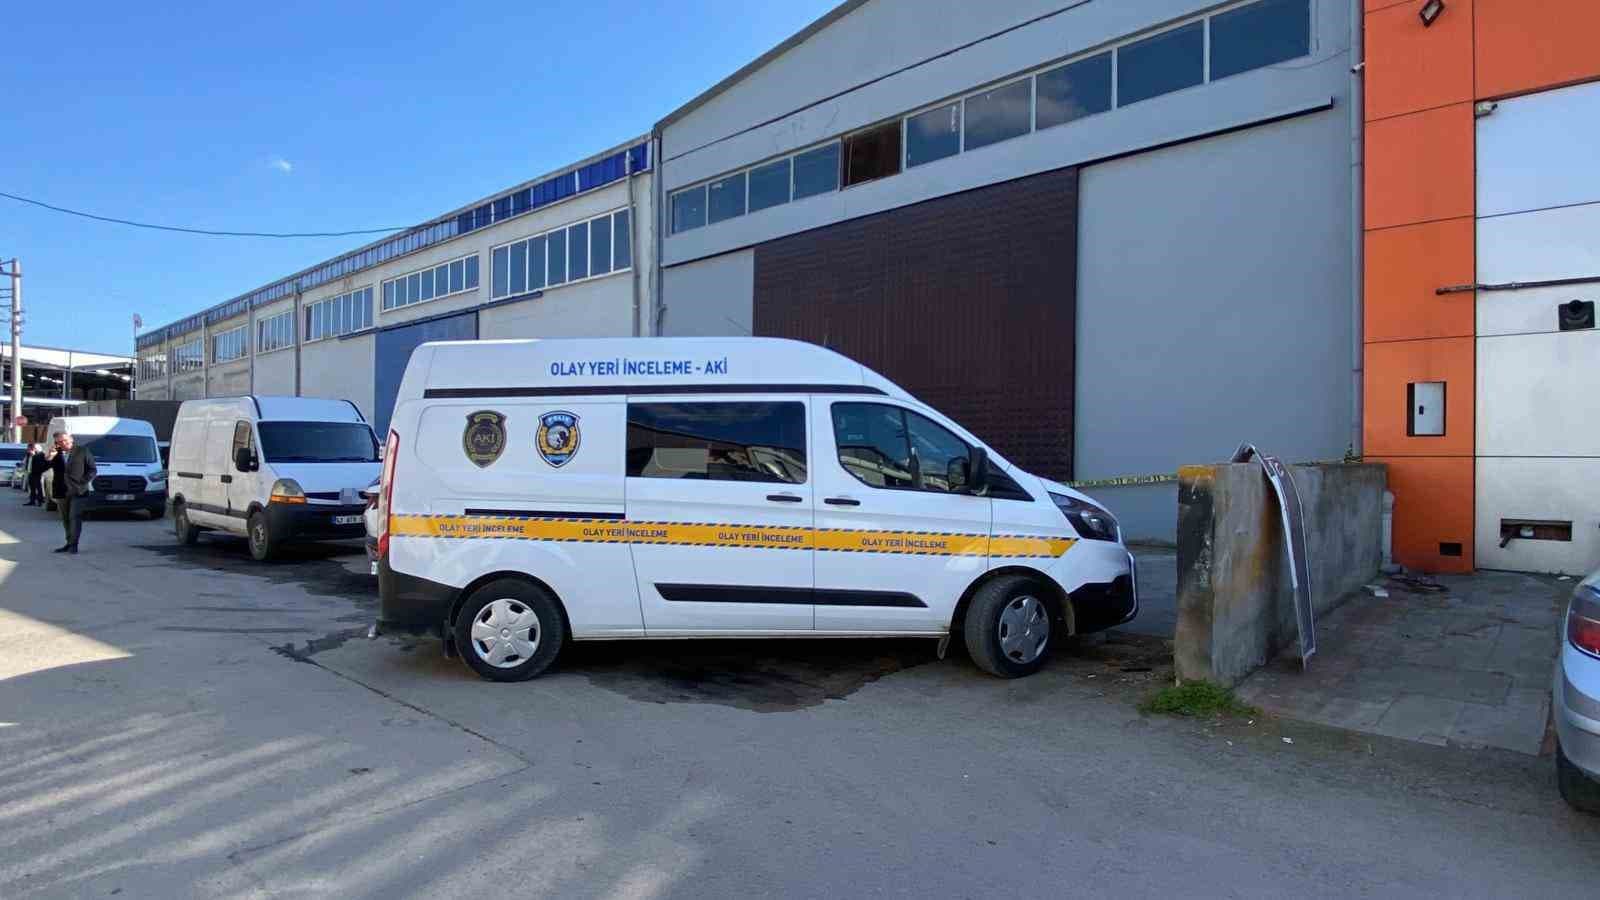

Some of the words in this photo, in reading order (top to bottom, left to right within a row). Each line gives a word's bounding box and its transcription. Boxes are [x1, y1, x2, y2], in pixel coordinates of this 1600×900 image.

[551, 361, 586, 376] OLAY
[588, 357, 619, 376] YERİ
[623, 357, 692, 376] İNCELEME
[704, 356, 728, 375] AKİ
[440, 522, 460, 532] OLAY
[463, 522, 481, 533] YERİ
[482, 523, 525, 534] İNCELEME
[583, 527, 604, 537] OLAY
[605, 527, 625, 537] YERİ
[626, 527, 668, 538] İNCELEME
[718, 532, 739, 541] OLAY
[741, 531, 760, 542] YERİ
[761, 532, 804, 544] İNCELEME
[862, 537, 882, 546] OLAY
[883, 537, 902, 547] YERİ
[903, 537, 946, 549] İNCELEME
